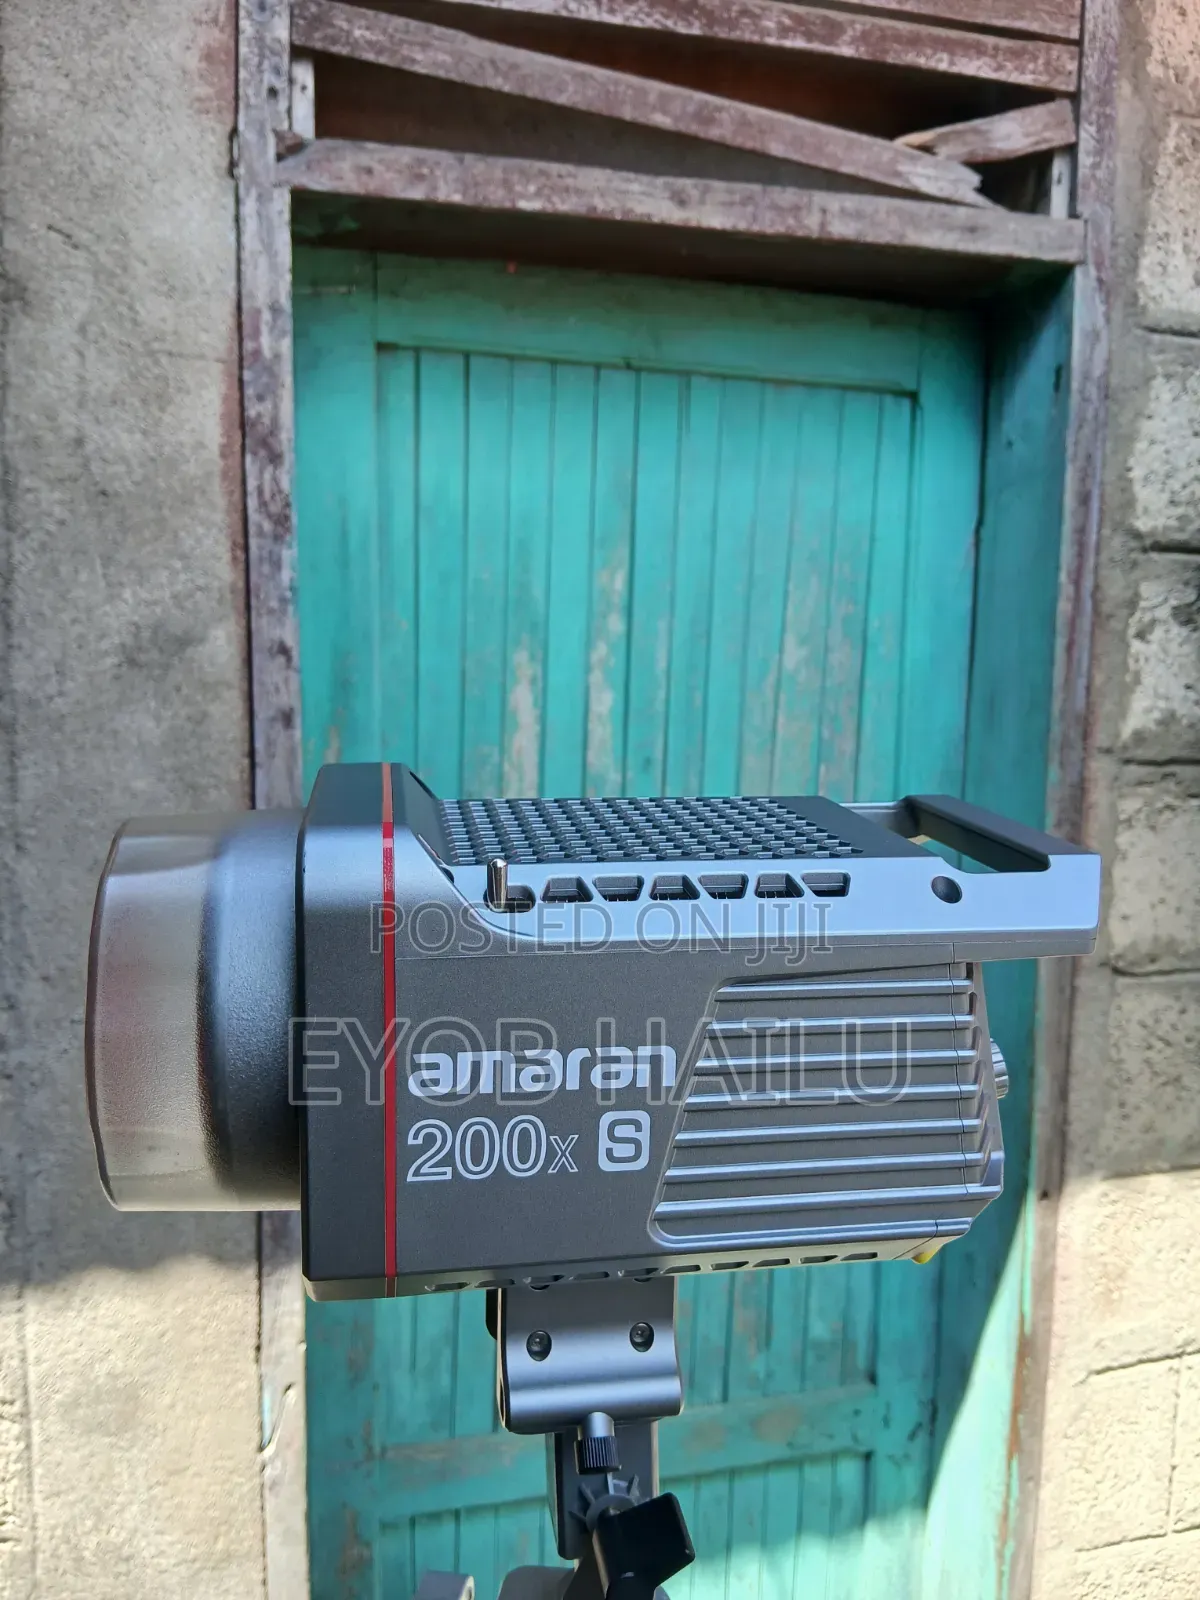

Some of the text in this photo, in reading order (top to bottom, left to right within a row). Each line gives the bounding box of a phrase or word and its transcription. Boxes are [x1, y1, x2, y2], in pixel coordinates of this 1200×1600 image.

[407, 1045, 678, 1098] amaran
[406, 1115, 645, 1183] 200x S
